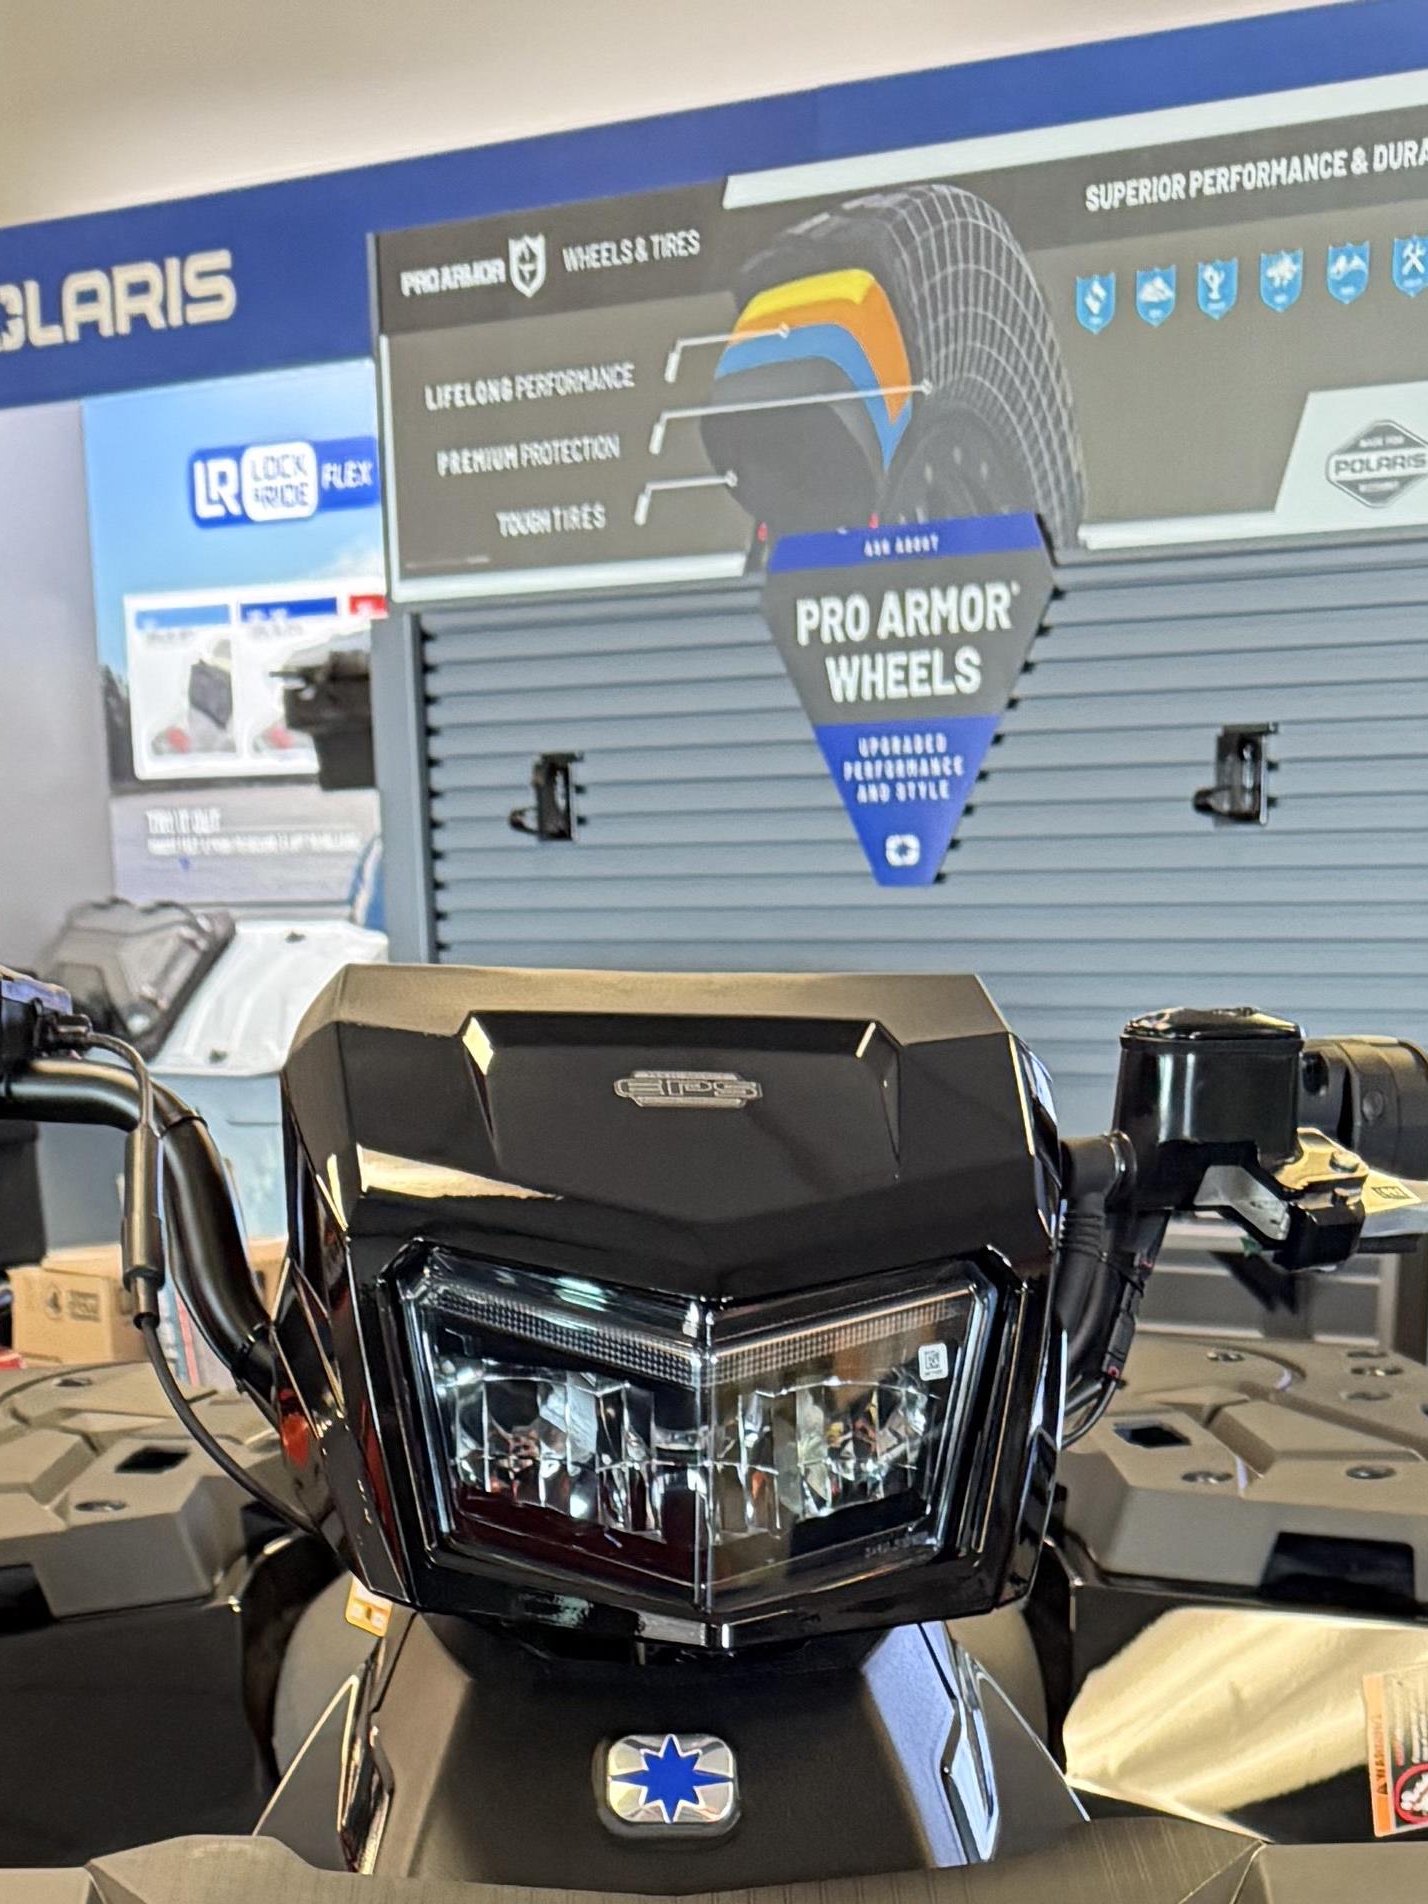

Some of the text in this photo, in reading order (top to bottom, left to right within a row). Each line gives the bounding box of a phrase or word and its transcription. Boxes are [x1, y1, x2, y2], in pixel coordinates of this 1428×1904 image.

[1085, 172, 1185, 212] SUPERIOR
[1188, 150, 1348, 198] PERFORMANCE
[1351, 146, 1369, 175] &
[562, 240, 632, 273] WHEELS
[633, 234, 647, 263] &
[649, 228, 701, 260] TIRES
[425, 361, 636, 411] LIFELONG PERFORMANCE
[250, 453, 308, 482] LOCK
[322, 460, 373, 490] FLEX
[436, 433, 621, 477] PREMIUM PROTECTION
[1335, 453, 1427, 477] POLARIS
[552, 501, 607, 532] TIRES
[796, 593, 871, 647] PRO
[825, 645, 983, 703] WHEELS
